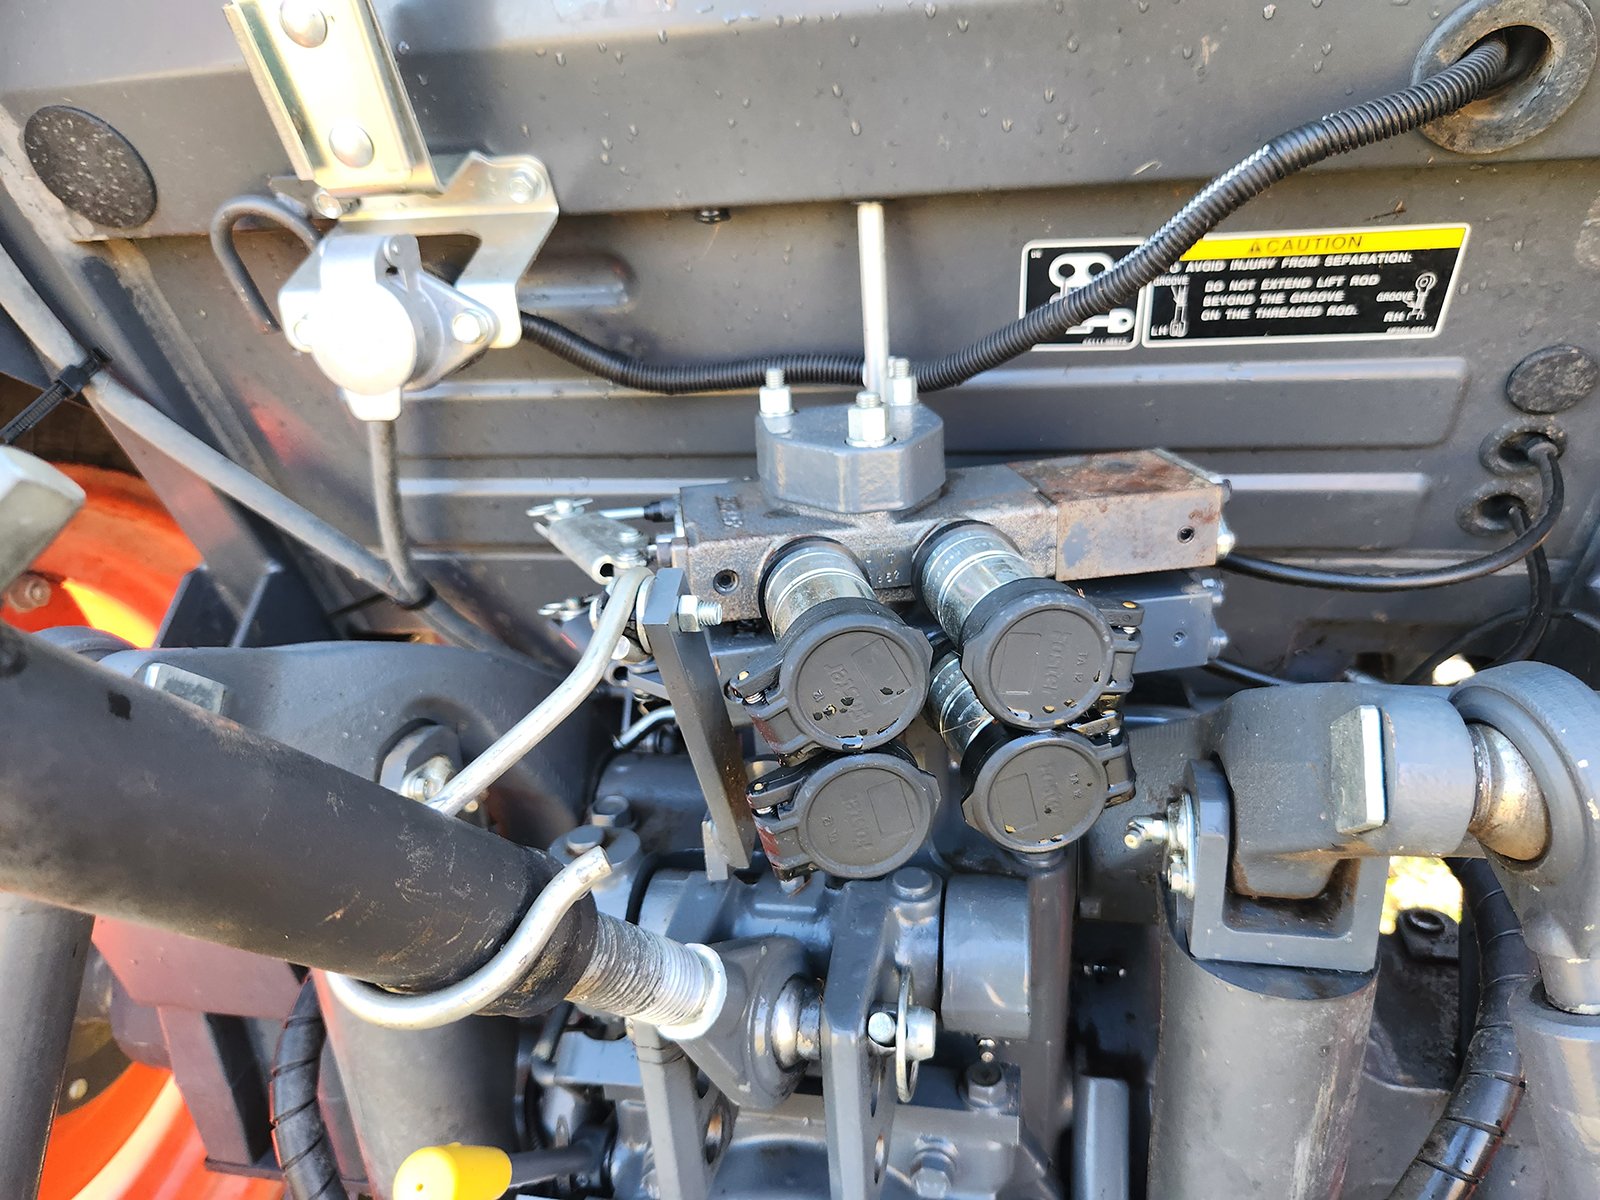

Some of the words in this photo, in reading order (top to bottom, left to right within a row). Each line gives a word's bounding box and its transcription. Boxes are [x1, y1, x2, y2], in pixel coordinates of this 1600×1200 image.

[1266, 236, 1363, 253] CAUTION
[1185, 259, 1226, 273] AVOID
[1229, 257, 1277, 271] INJURY
[1280, 255, 1320, 269] FROM
[1324, 251, 1413, 267] SEPARATION:
[1204, 280, 1226, 293] DO
[1228, 278, 1256, 291] NOT
[1260, 276, 1314, 290] EXTEND
[1316, 275, 1346, 288] LIFT
[1349, 274, 1381, 287] ROD
[1202, 293, 1256, 307] BEYOND
[1260, 292, 1286, 305] THE
[1289, 290, 1345, 304] GROOVE
[1376, 290, 1415, 302] GROOVE
[1200, 309, 1222, 321] ON
[1225, 307, 1251, 320] THE
[1255, 305, 1324, 319] THREADED
[1383, 311, 1406, 322] RH
[1150, 324, 1169, 336] LH
